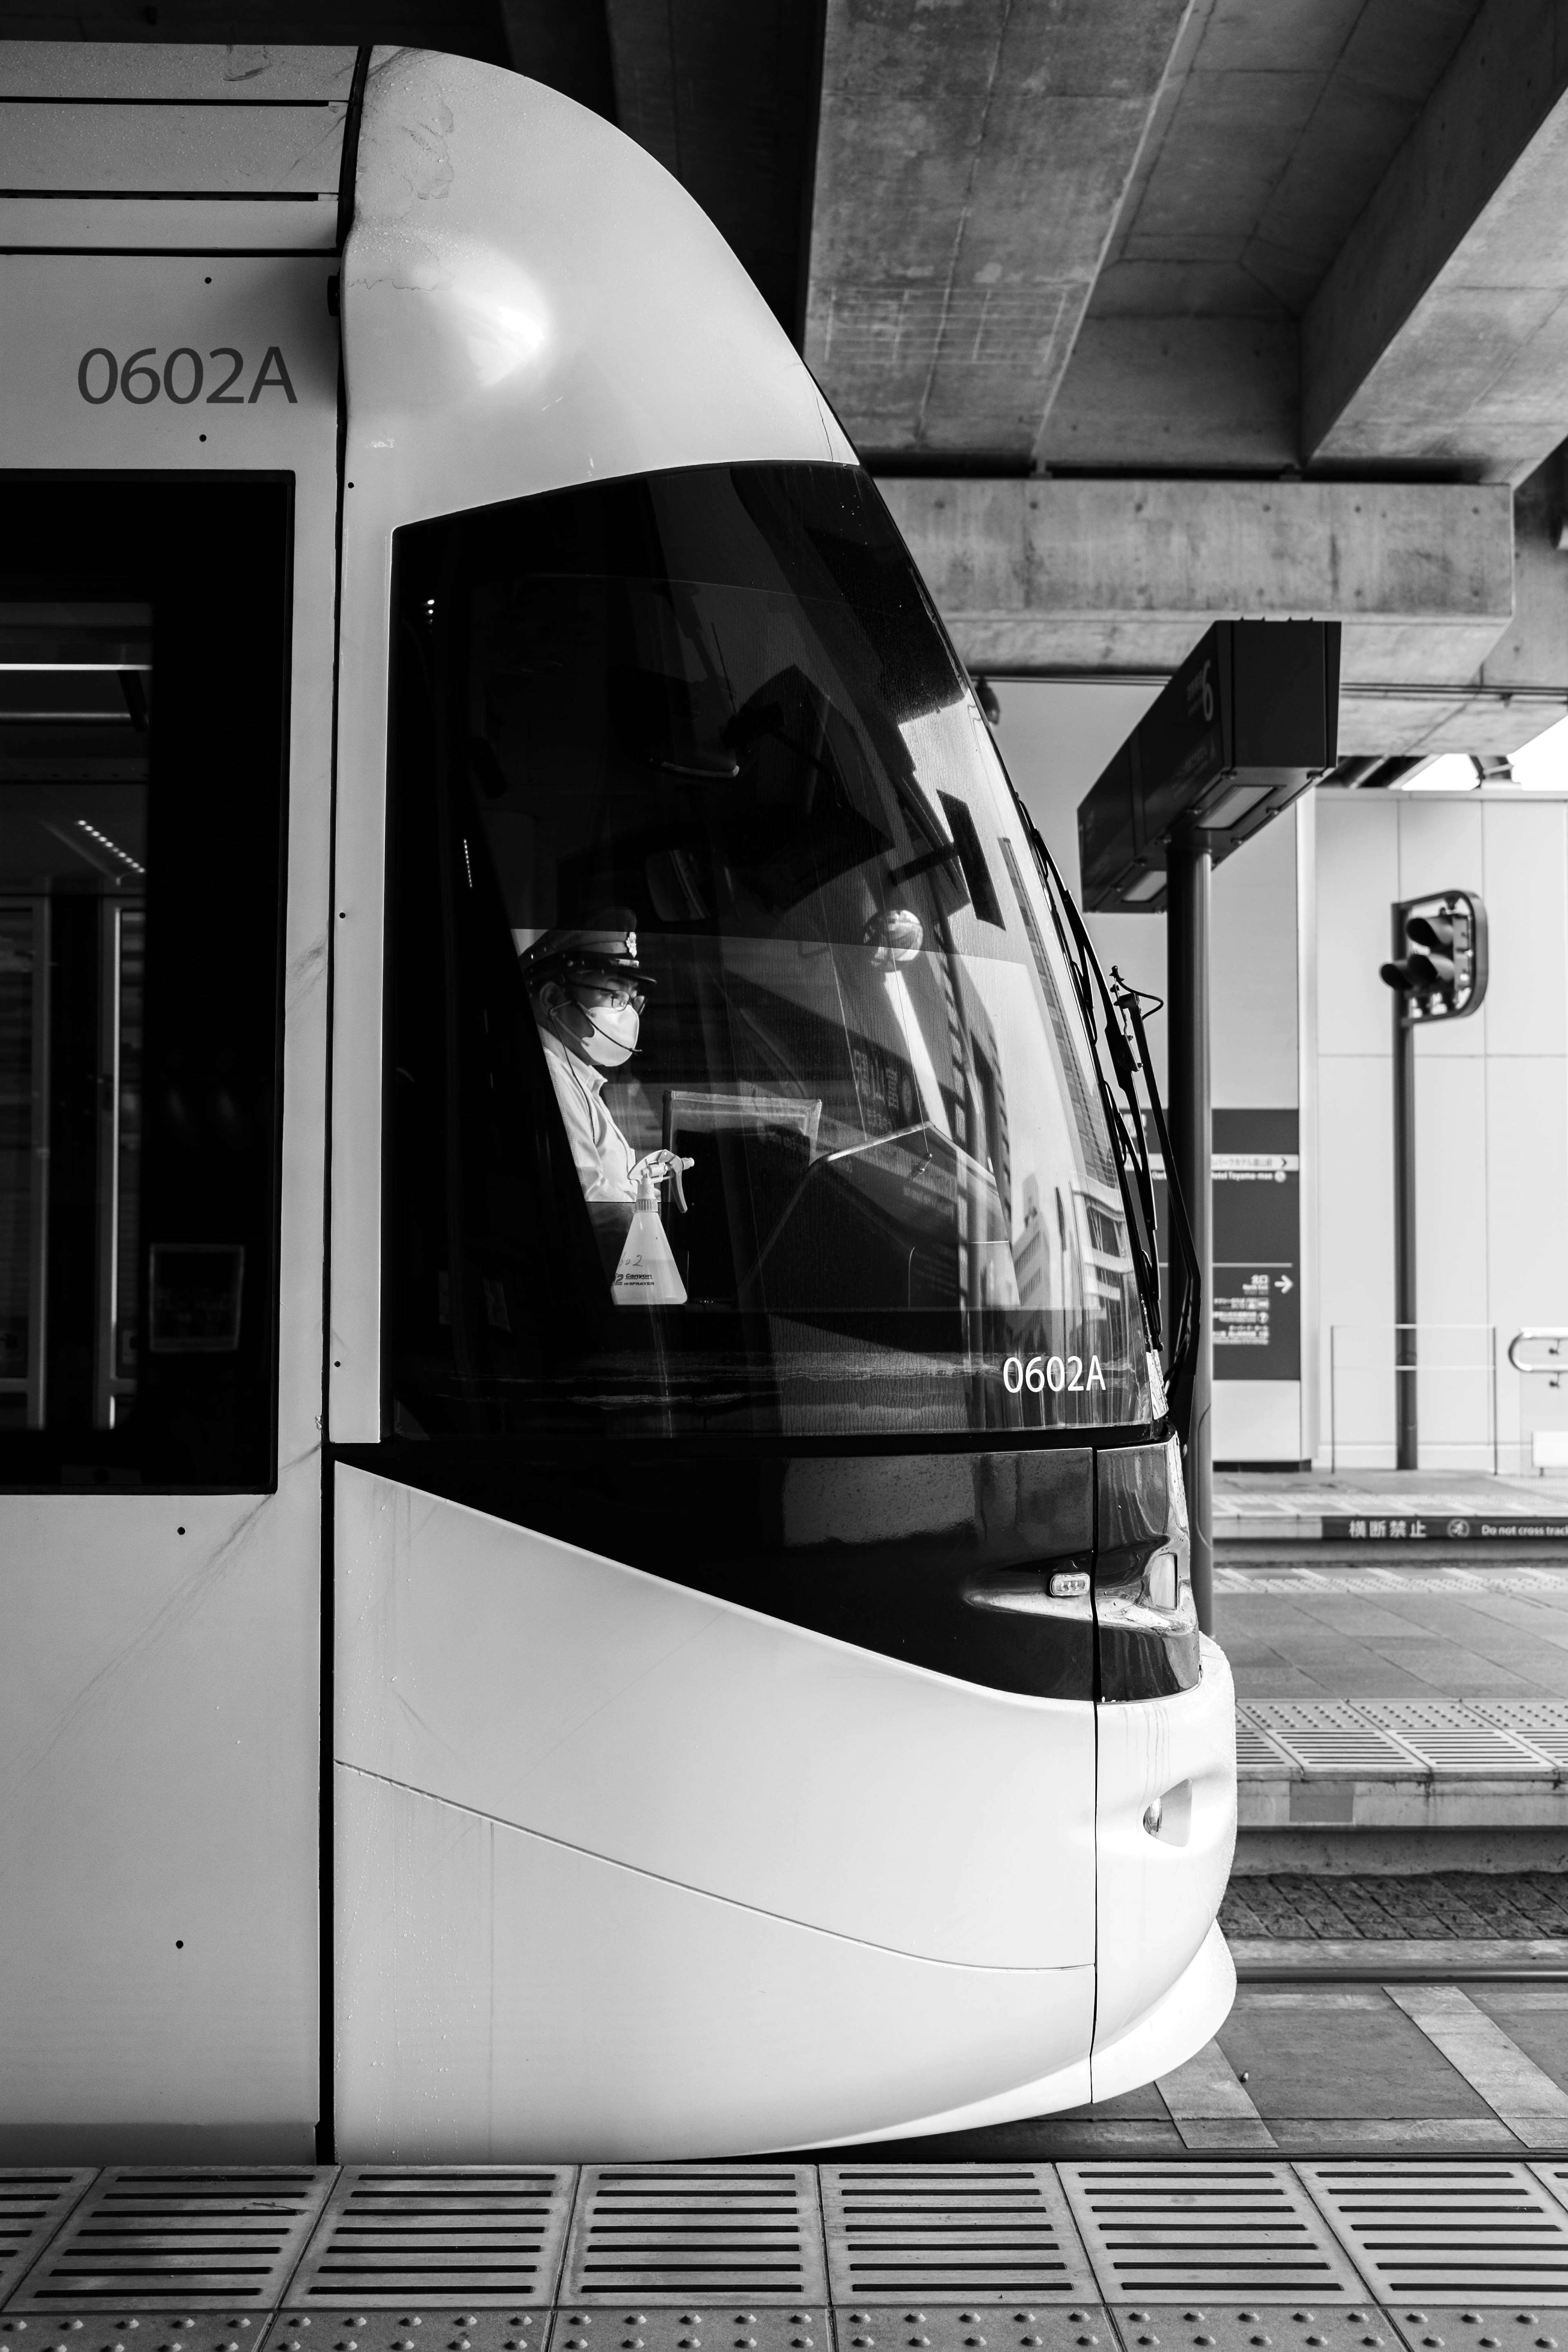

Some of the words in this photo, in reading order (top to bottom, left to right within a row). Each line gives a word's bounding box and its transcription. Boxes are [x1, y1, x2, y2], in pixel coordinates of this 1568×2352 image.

[78, 346, 298, 405] 0602A
[1003, 1355, 1106, 1393] 0602A
[1348, 1519, 1427, 1539] 横断禁止
[1481, 1524, 1497, 1536] Do
[1498, 1526, 1517, 1536] not
[1518, 1526, 1545, 1537] cross
